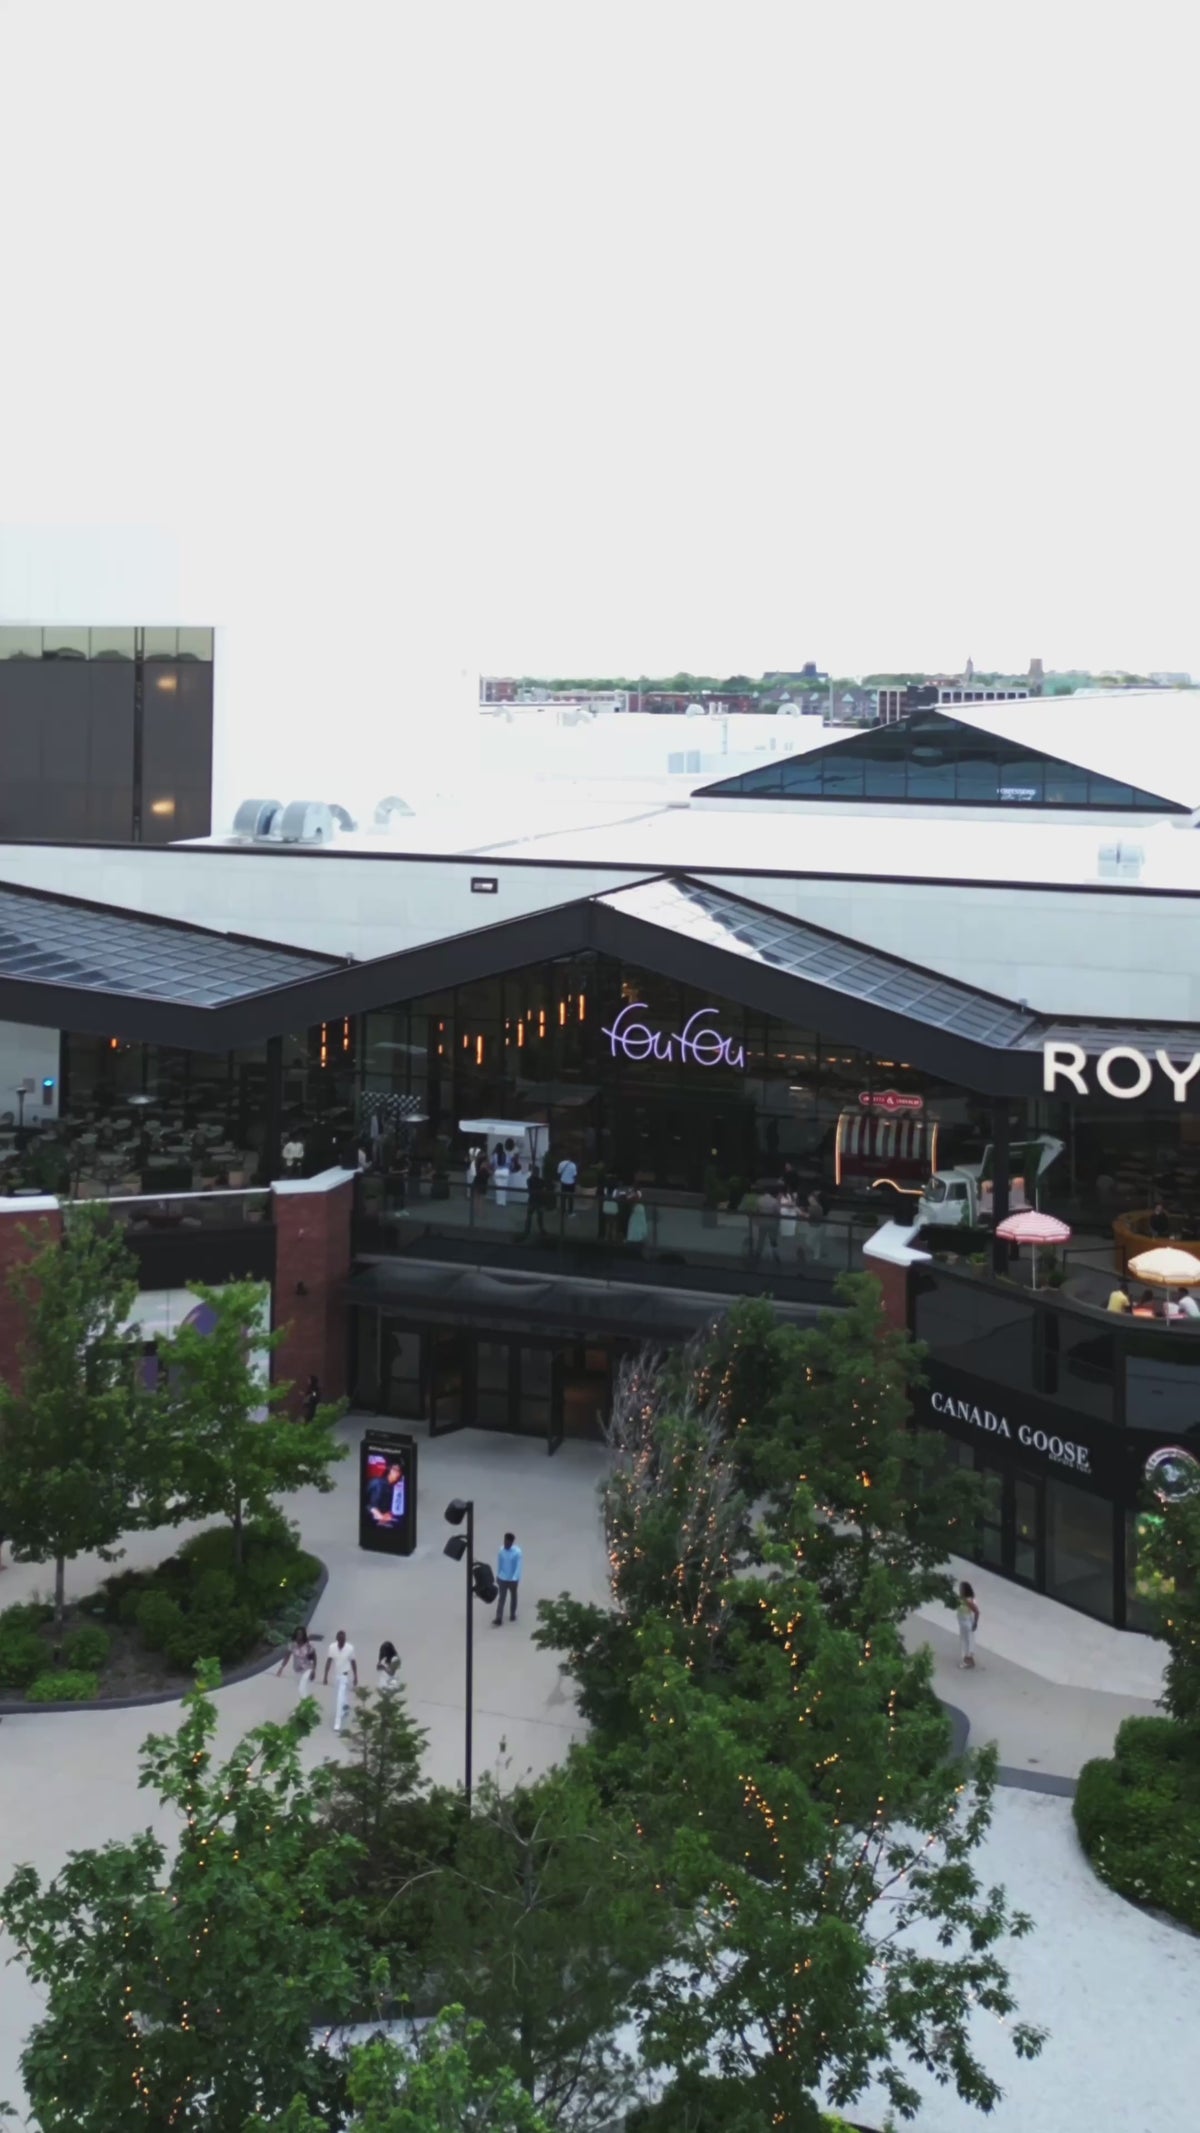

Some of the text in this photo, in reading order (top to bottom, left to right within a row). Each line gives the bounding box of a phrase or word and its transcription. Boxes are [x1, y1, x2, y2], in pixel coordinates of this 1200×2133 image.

[1043, 1041, 1200, 1102] ROY
[931, 1392, 1011, 1438] CANADA
[1018, 1425, 1089, 1467] GOOSE
